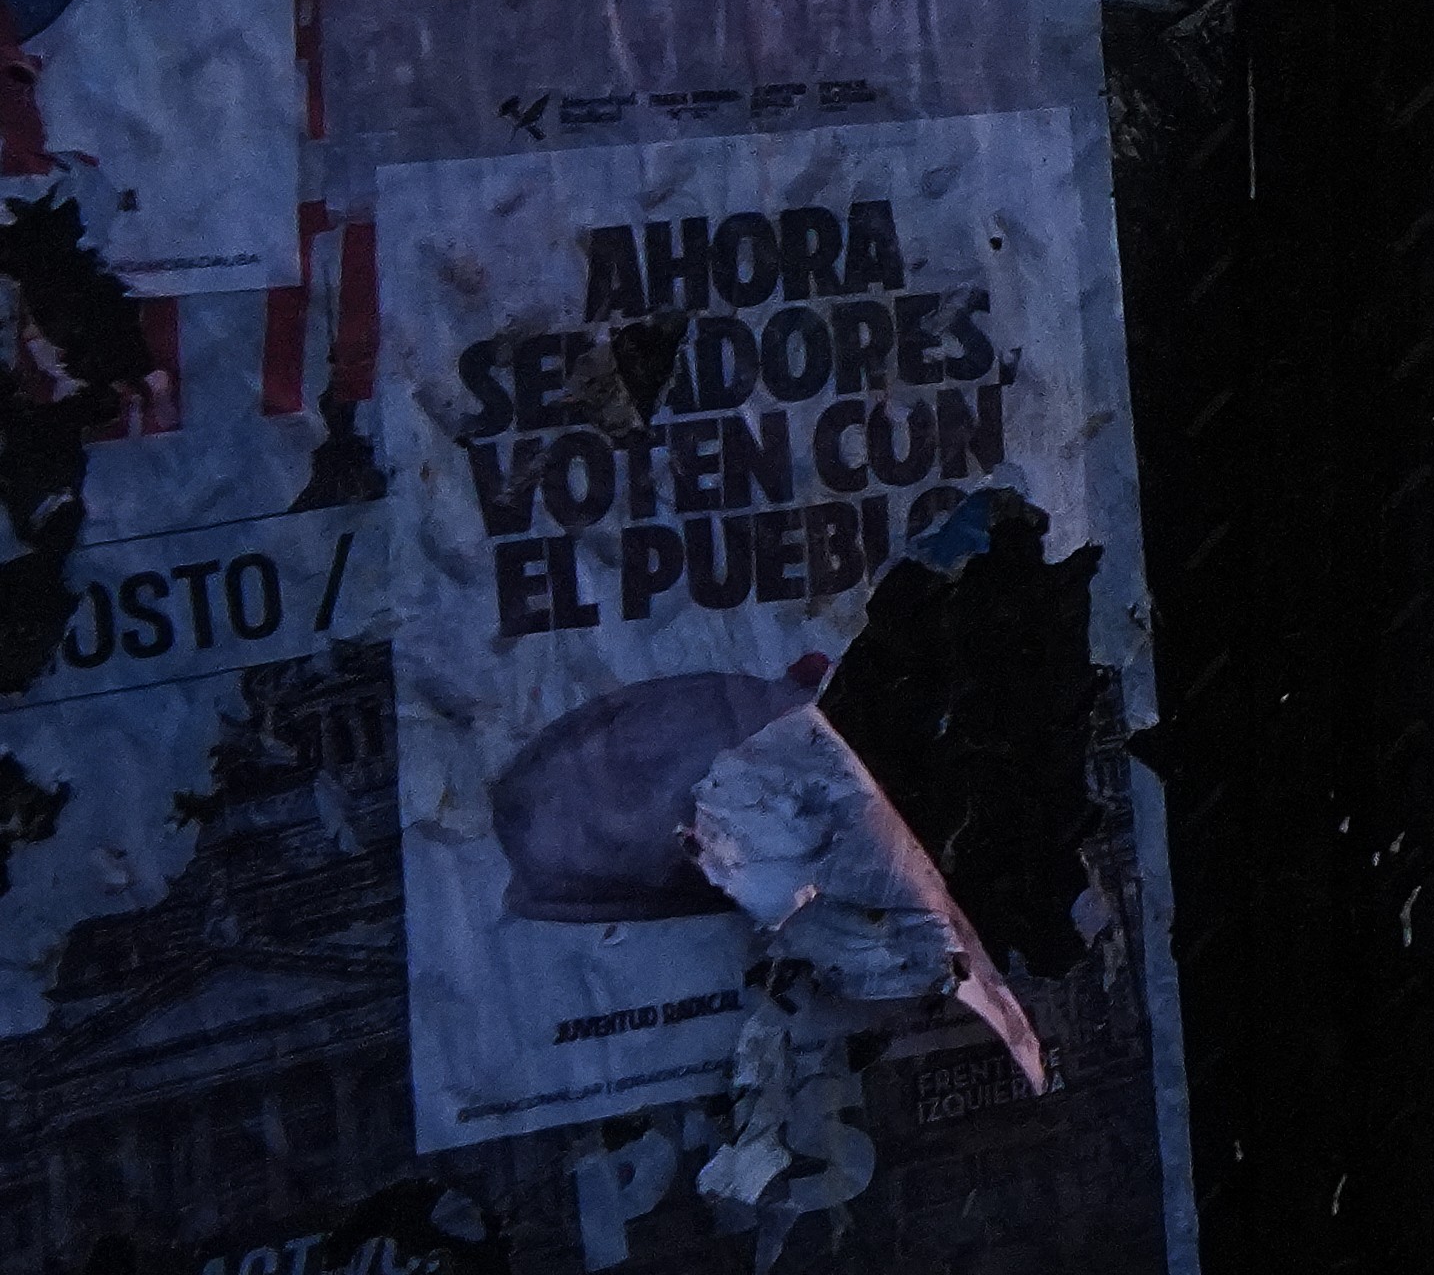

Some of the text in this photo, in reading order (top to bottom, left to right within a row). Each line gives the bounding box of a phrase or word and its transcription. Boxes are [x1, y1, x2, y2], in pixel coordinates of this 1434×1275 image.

[585, 200, 906, 323] AHORA
[458, 289, 1022, 439] SEADORES,
[467, 409, 795, 537] VOTEN
[494, 535, 601, 638] EL
[552, 1006, 658, 1046] JUVENTUD
